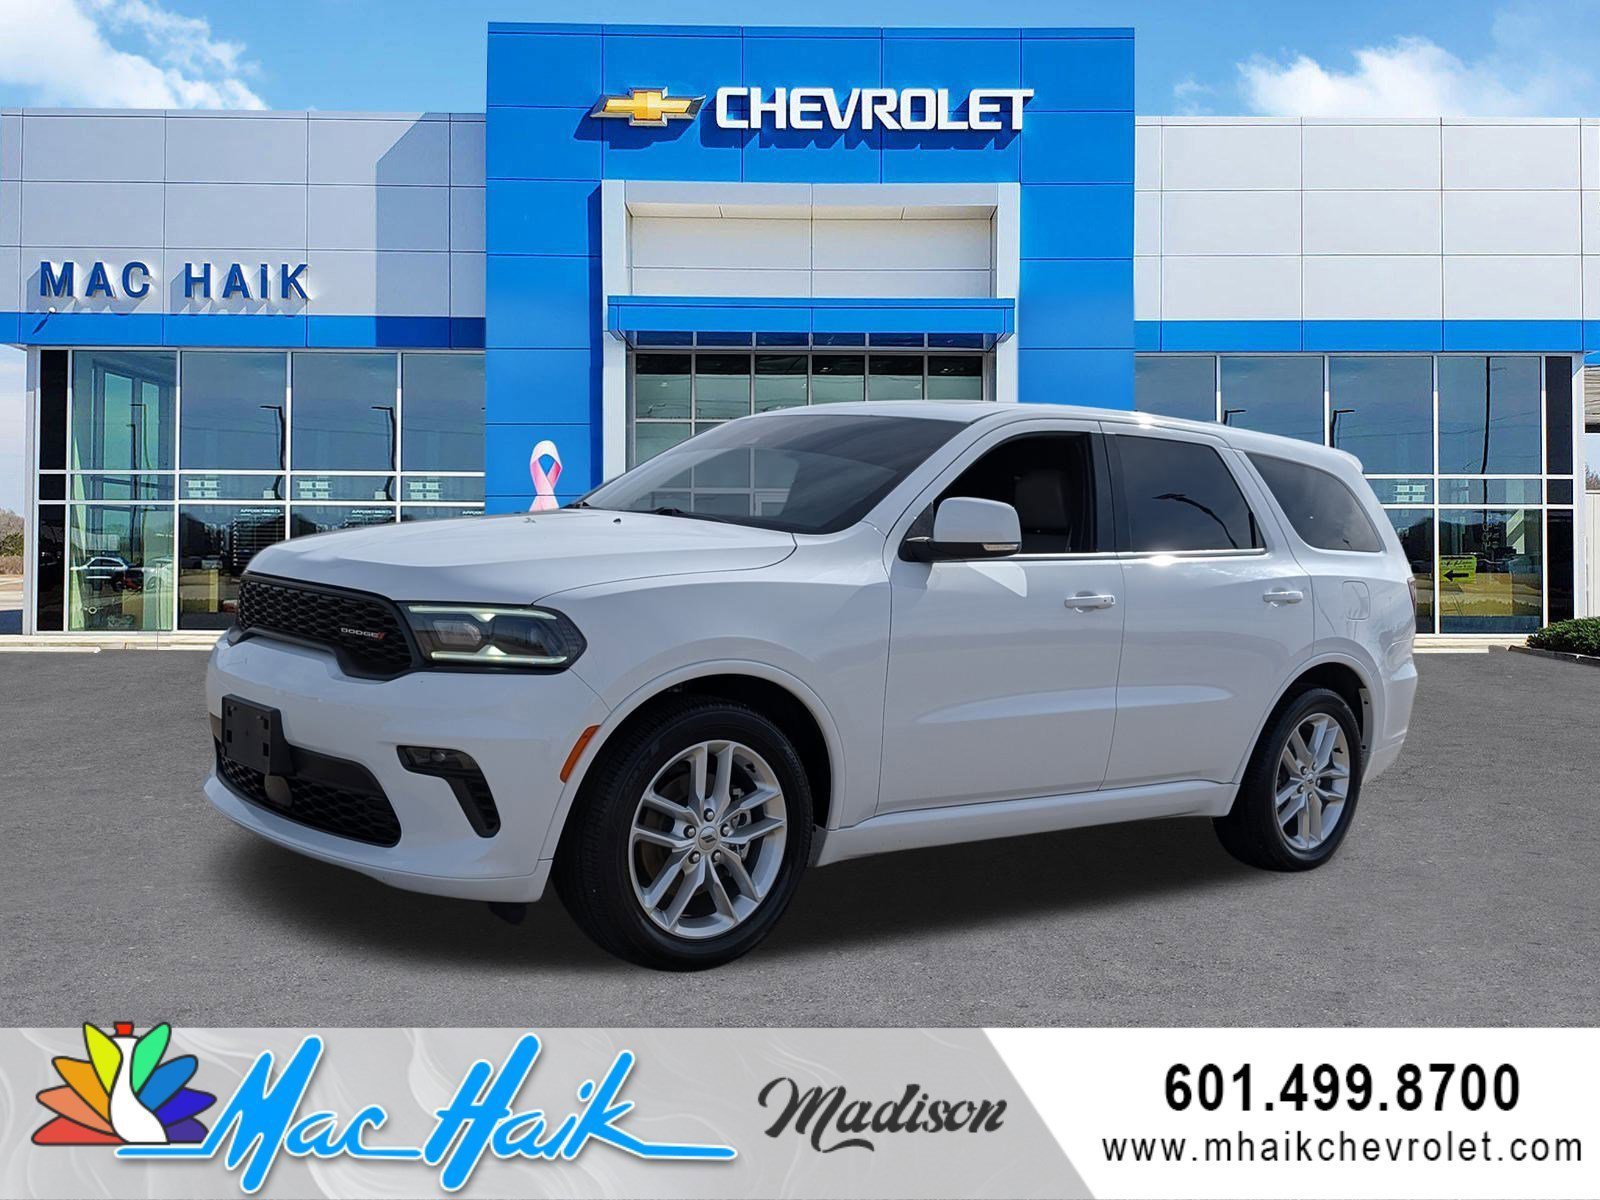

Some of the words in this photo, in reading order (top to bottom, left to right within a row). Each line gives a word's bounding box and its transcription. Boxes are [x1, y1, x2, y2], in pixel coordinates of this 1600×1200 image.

[715, 86, 1035, 131] CHEVROLET
[39, 260, 151, 299] MAC
[184, 261, 309, 300] HAIK
[340, 627, 380, 639] DODGE
